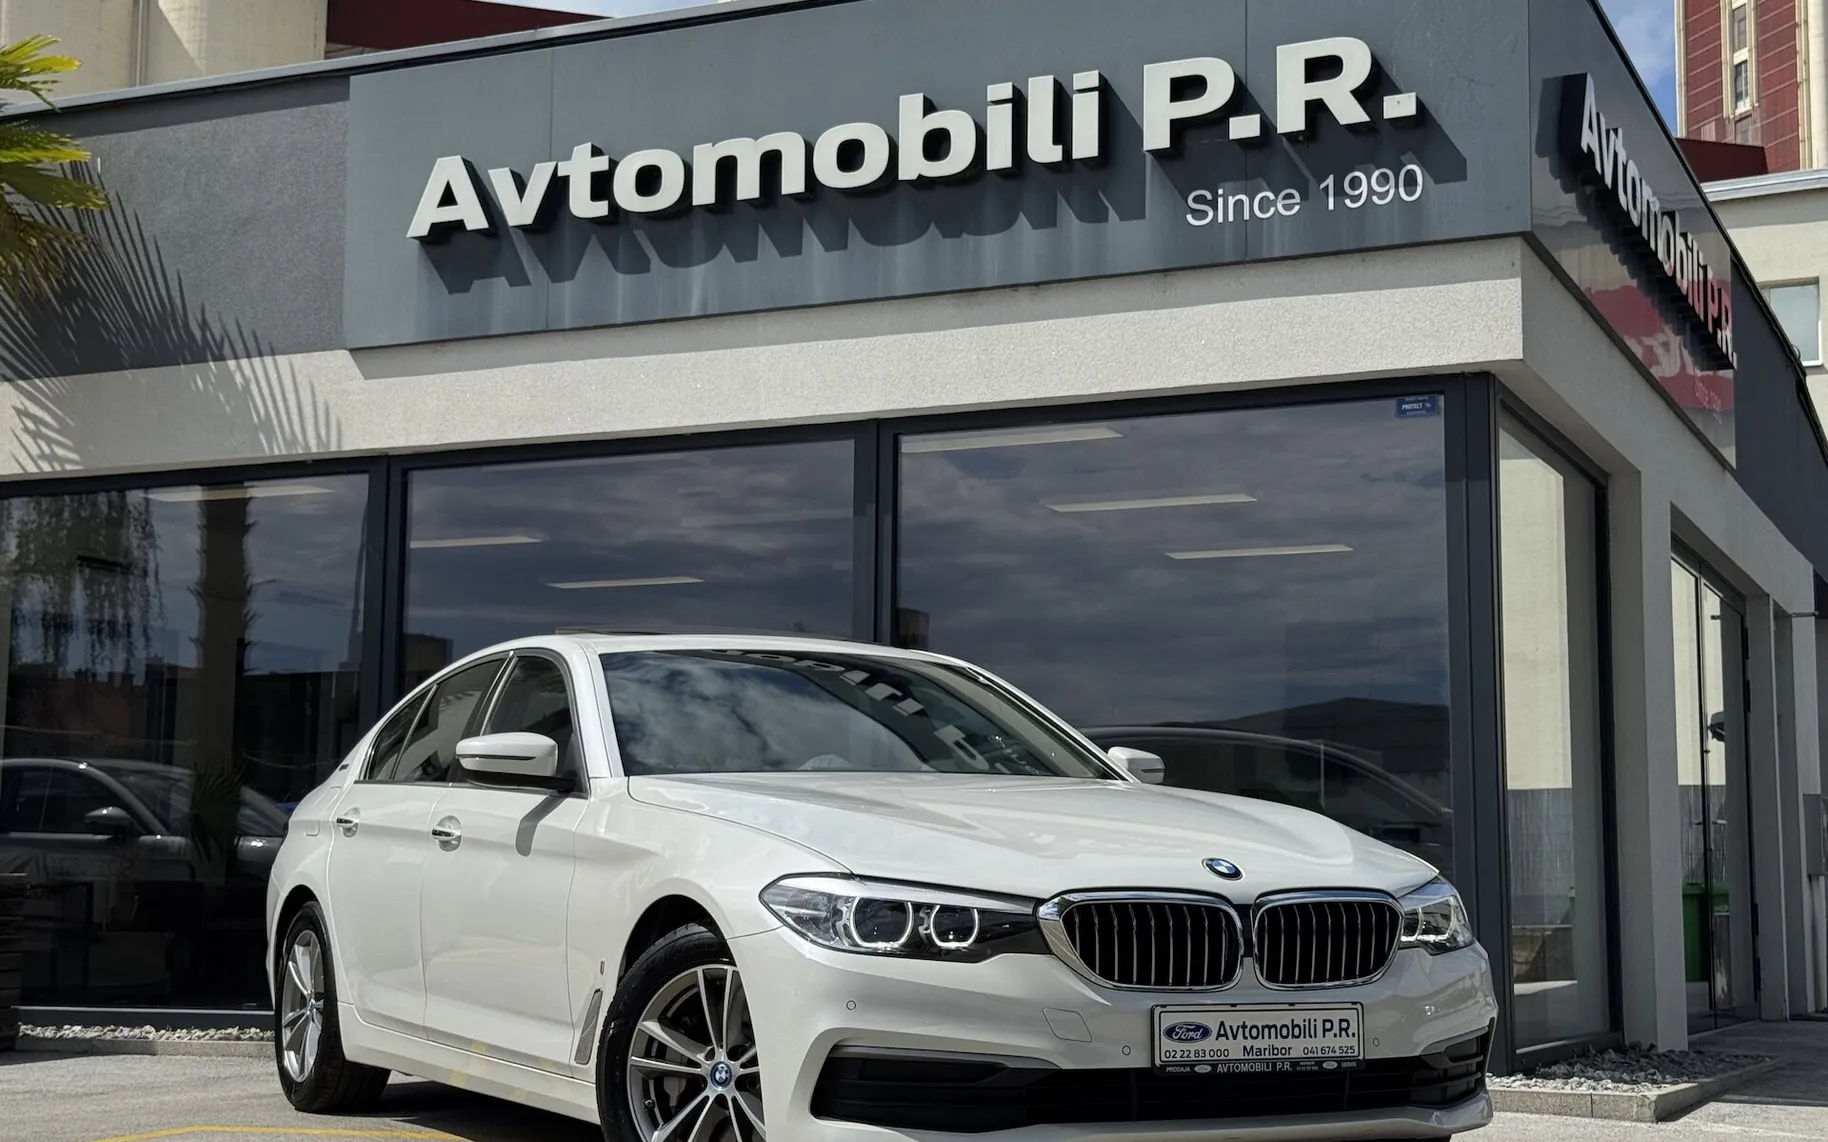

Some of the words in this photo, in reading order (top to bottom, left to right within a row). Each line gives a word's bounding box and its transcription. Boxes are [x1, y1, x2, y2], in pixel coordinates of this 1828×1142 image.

[406, 70, 1099, 238] Avtomobili
[1142, 37, 1417, 151] P.R.
[1185, 187, 1301, 227] Since
[1319, 164, 1424, 212] 1990
[1580, 72, 1704, 322] Avtomobili
[1707, 264, 1737, 371] P.R.
[1215, 1018, 1317, 1041] Avtomobili
[1322, 1018, 1356, 1039] P.R.
[1164, 1049, 1178, 1059] 02
[1179, 1049, 1192, 1059] 22
[1193, 1048, 1206, 1058] 83
[1208, 1048, 1230, 1058] 000
[1242, 1044, 1292, 1057] Maribor
[1302, 1046, 1319, 1056] 041
[1320, 1045, 1337, 1055] 674
[1338, 1045, 1356, 1055] 525
[1216, 1061, 1272, 1073] AVTOMOBILI
[1276, 1061, 1293, 1072] P.R.
